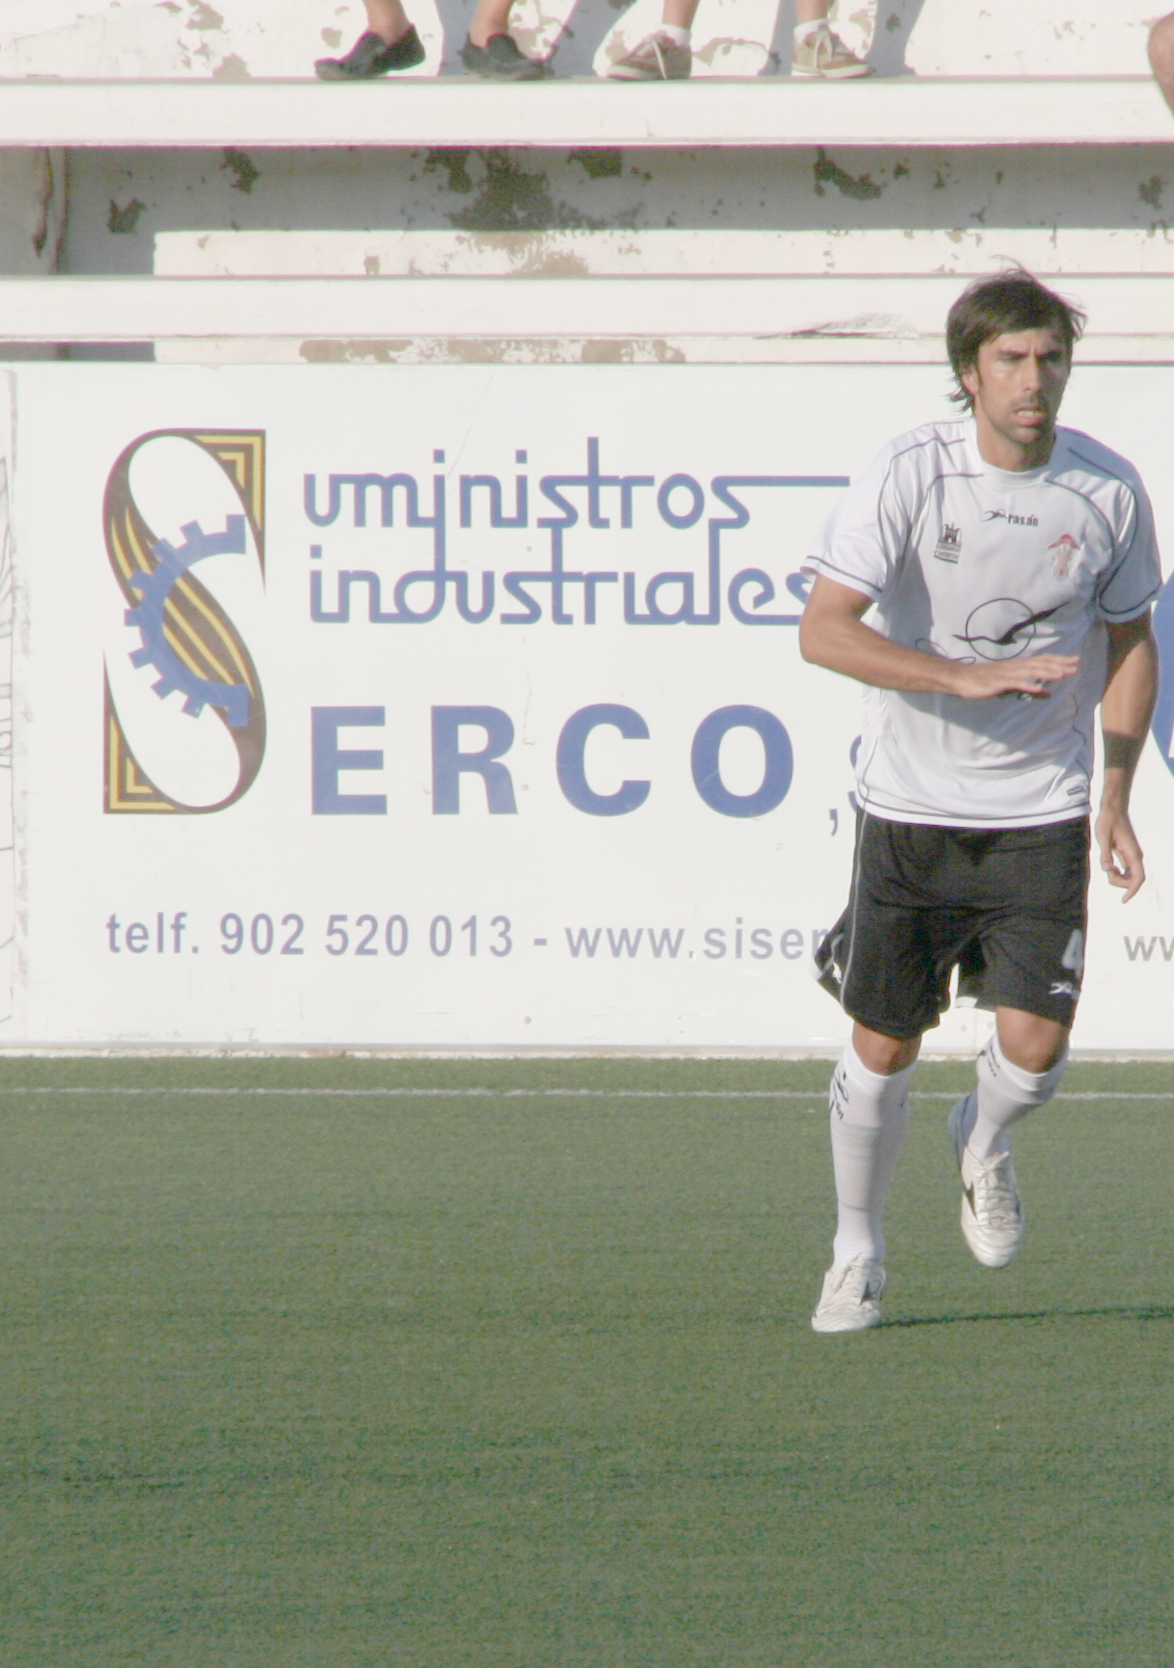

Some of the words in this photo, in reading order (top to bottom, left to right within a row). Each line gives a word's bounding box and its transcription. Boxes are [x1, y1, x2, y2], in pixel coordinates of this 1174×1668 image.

[106, 911, 199, 954] telf.
[219, 912, 305, 956] 902
[325, 914, 409, 957] 520
[429, 914, 513, 958] 013
